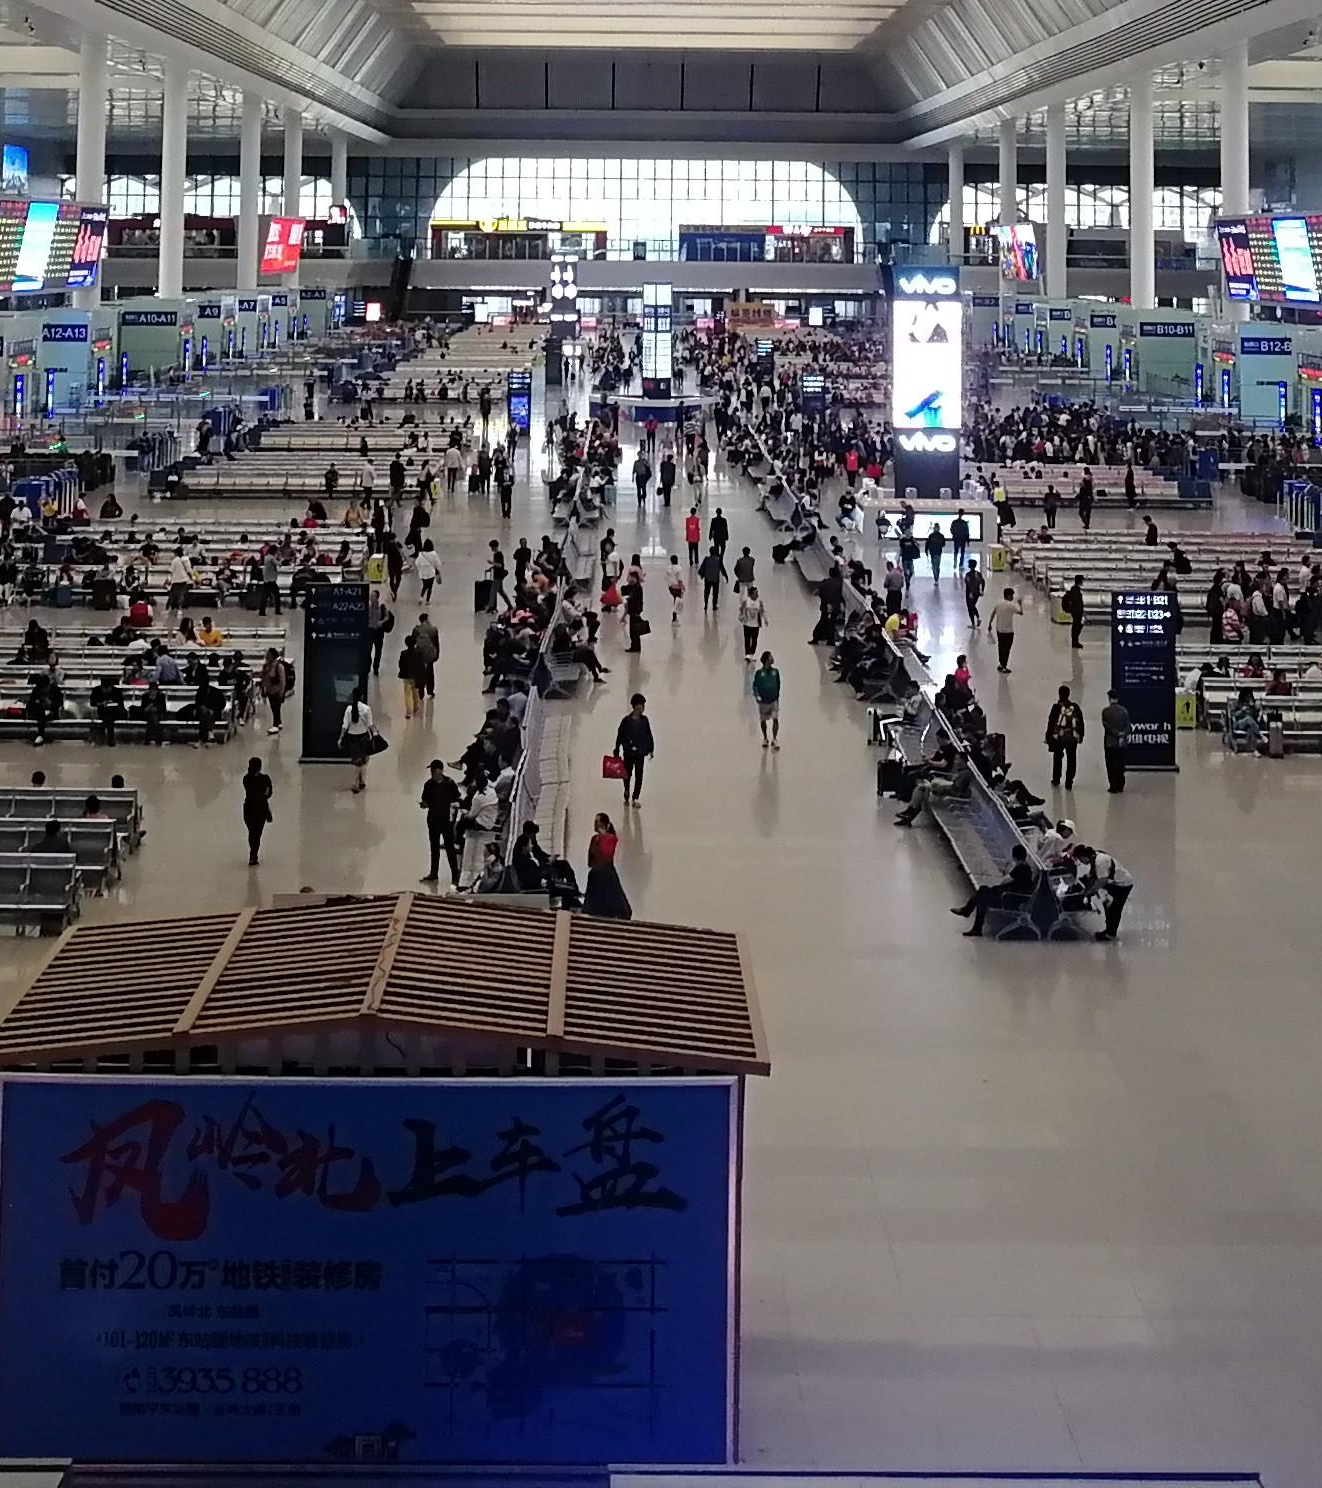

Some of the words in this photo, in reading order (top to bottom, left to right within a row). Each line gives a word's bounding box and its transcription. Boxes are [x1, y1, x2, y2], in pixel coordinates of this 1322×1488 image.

[139, 313, 176, 324] A10-A11
[43, 328, 86, 339] A12-A13
[1156, 325, 1193, 334] B10-B11
[156, 1367, 234, 1393] 3935
[240, 1367, 303, 1393] 888
